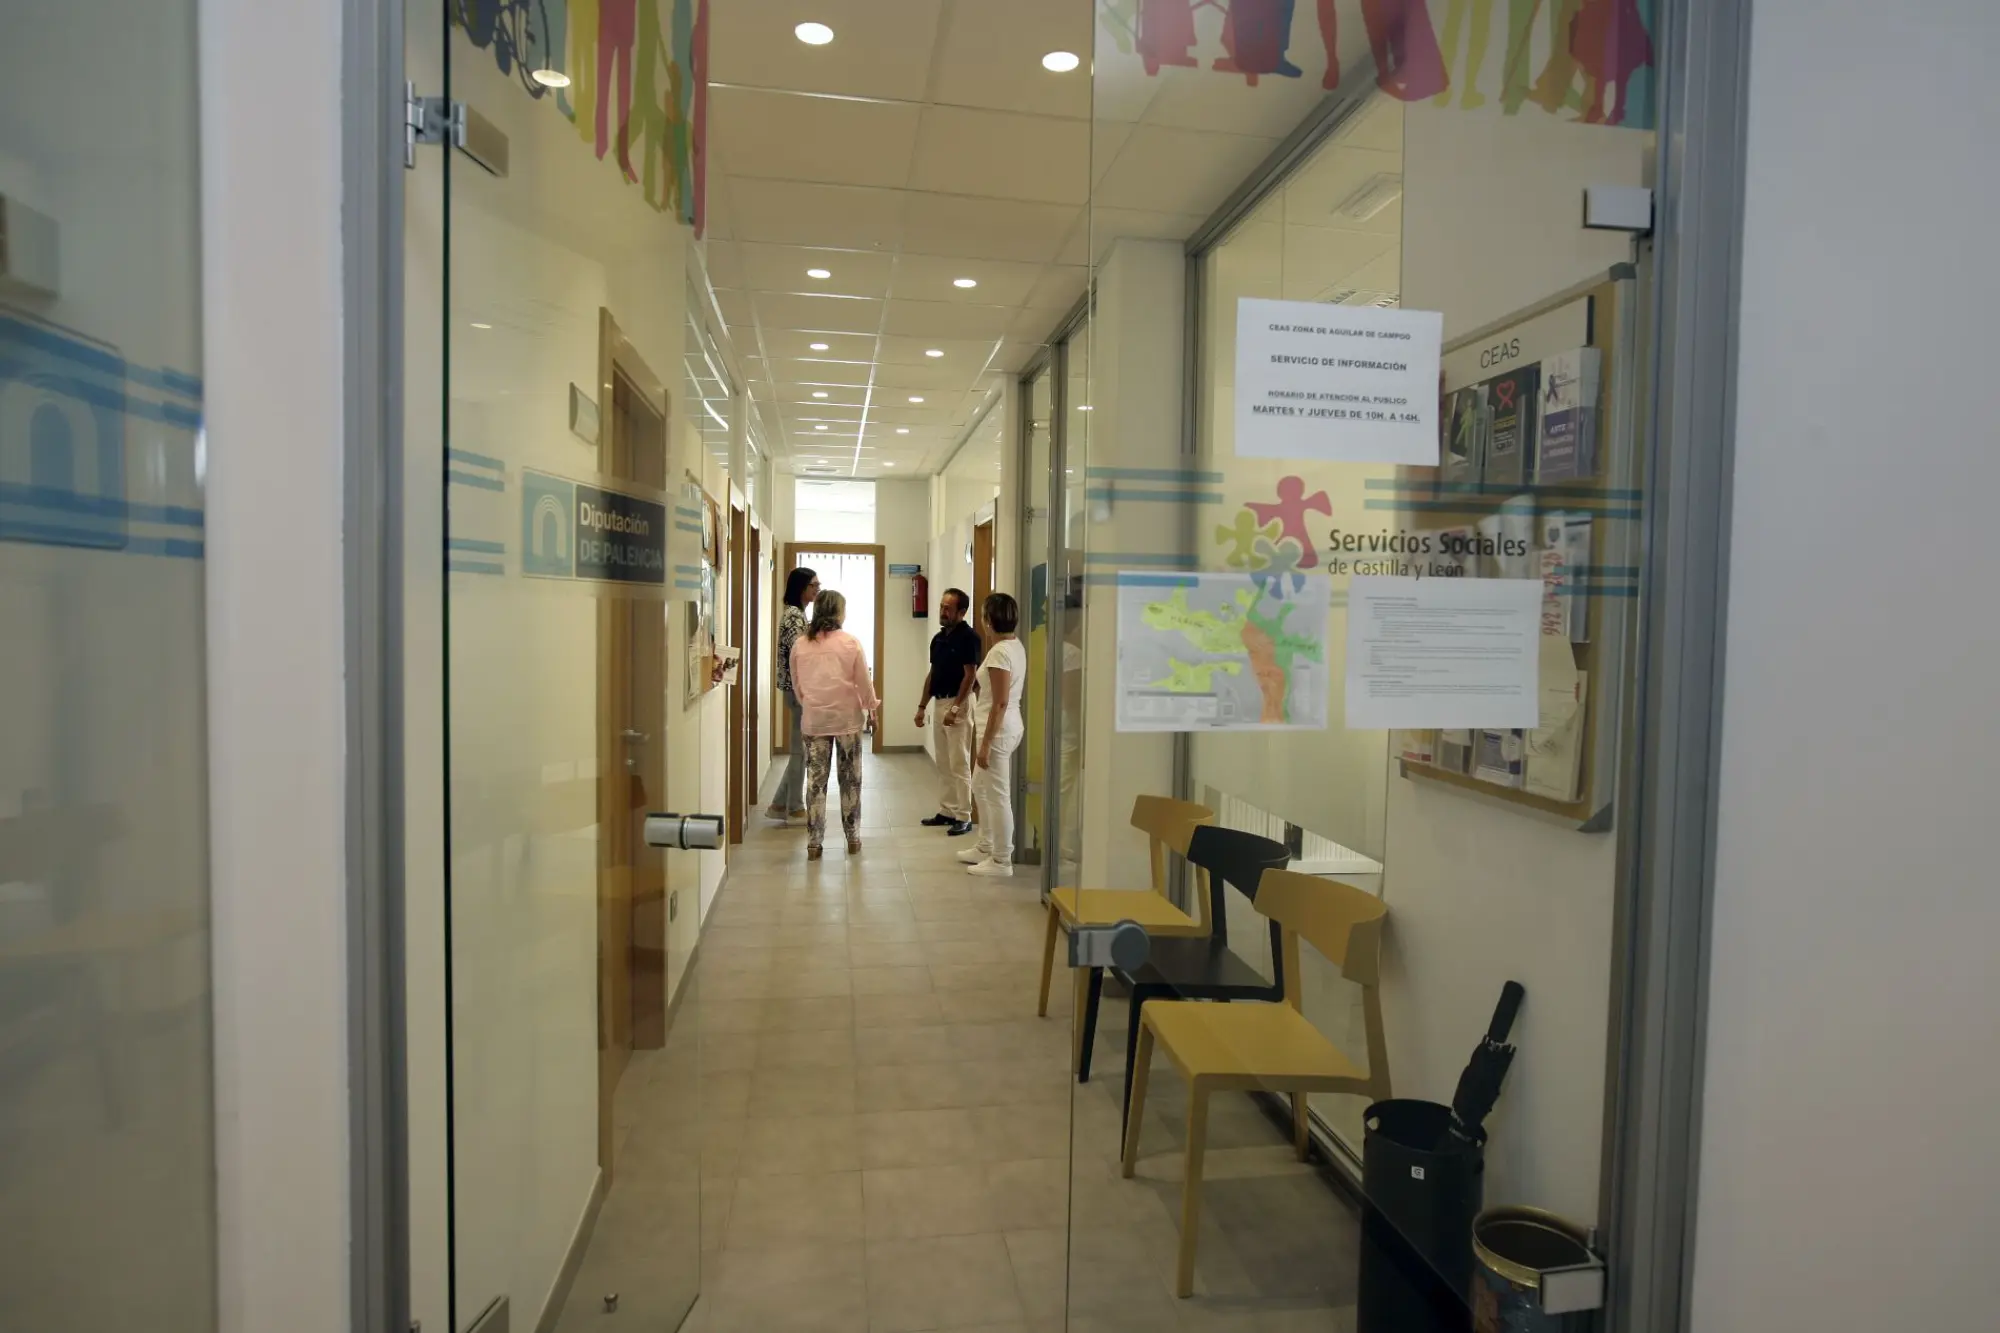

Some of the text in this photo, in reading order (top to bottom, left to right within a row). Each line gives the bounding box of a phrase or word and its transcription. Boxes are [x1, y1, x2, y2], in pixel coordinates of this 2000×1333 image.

[1269, 323, 1411, 341] CEAS ZONA DE AGUILAR DE CAMPOO
[1271, 354, 1407, 372] SERVICIO DE INFORMACIÓN
[1480, 338, 1521, 369] CEAS
[1268, 390, 1305, 400] HORARIO
[1307, 392, 1317, 400] DE
[1253, 405, 1295, 416] MARTES
[1299, 407, 1305, 416] Y
[1308, 407, 1347, 418] JUEVES
[1350, 410, 1362, 419] DE
[1390, 412, 1397, 421] A
[580, 502, 650, 536] Diputación
[580, 539, 664, 569] DE PALENCIA
[1329, 529, 1527, 557] Servicios Sociales
[1328, 557, 1464, 581] de Castilla y León
